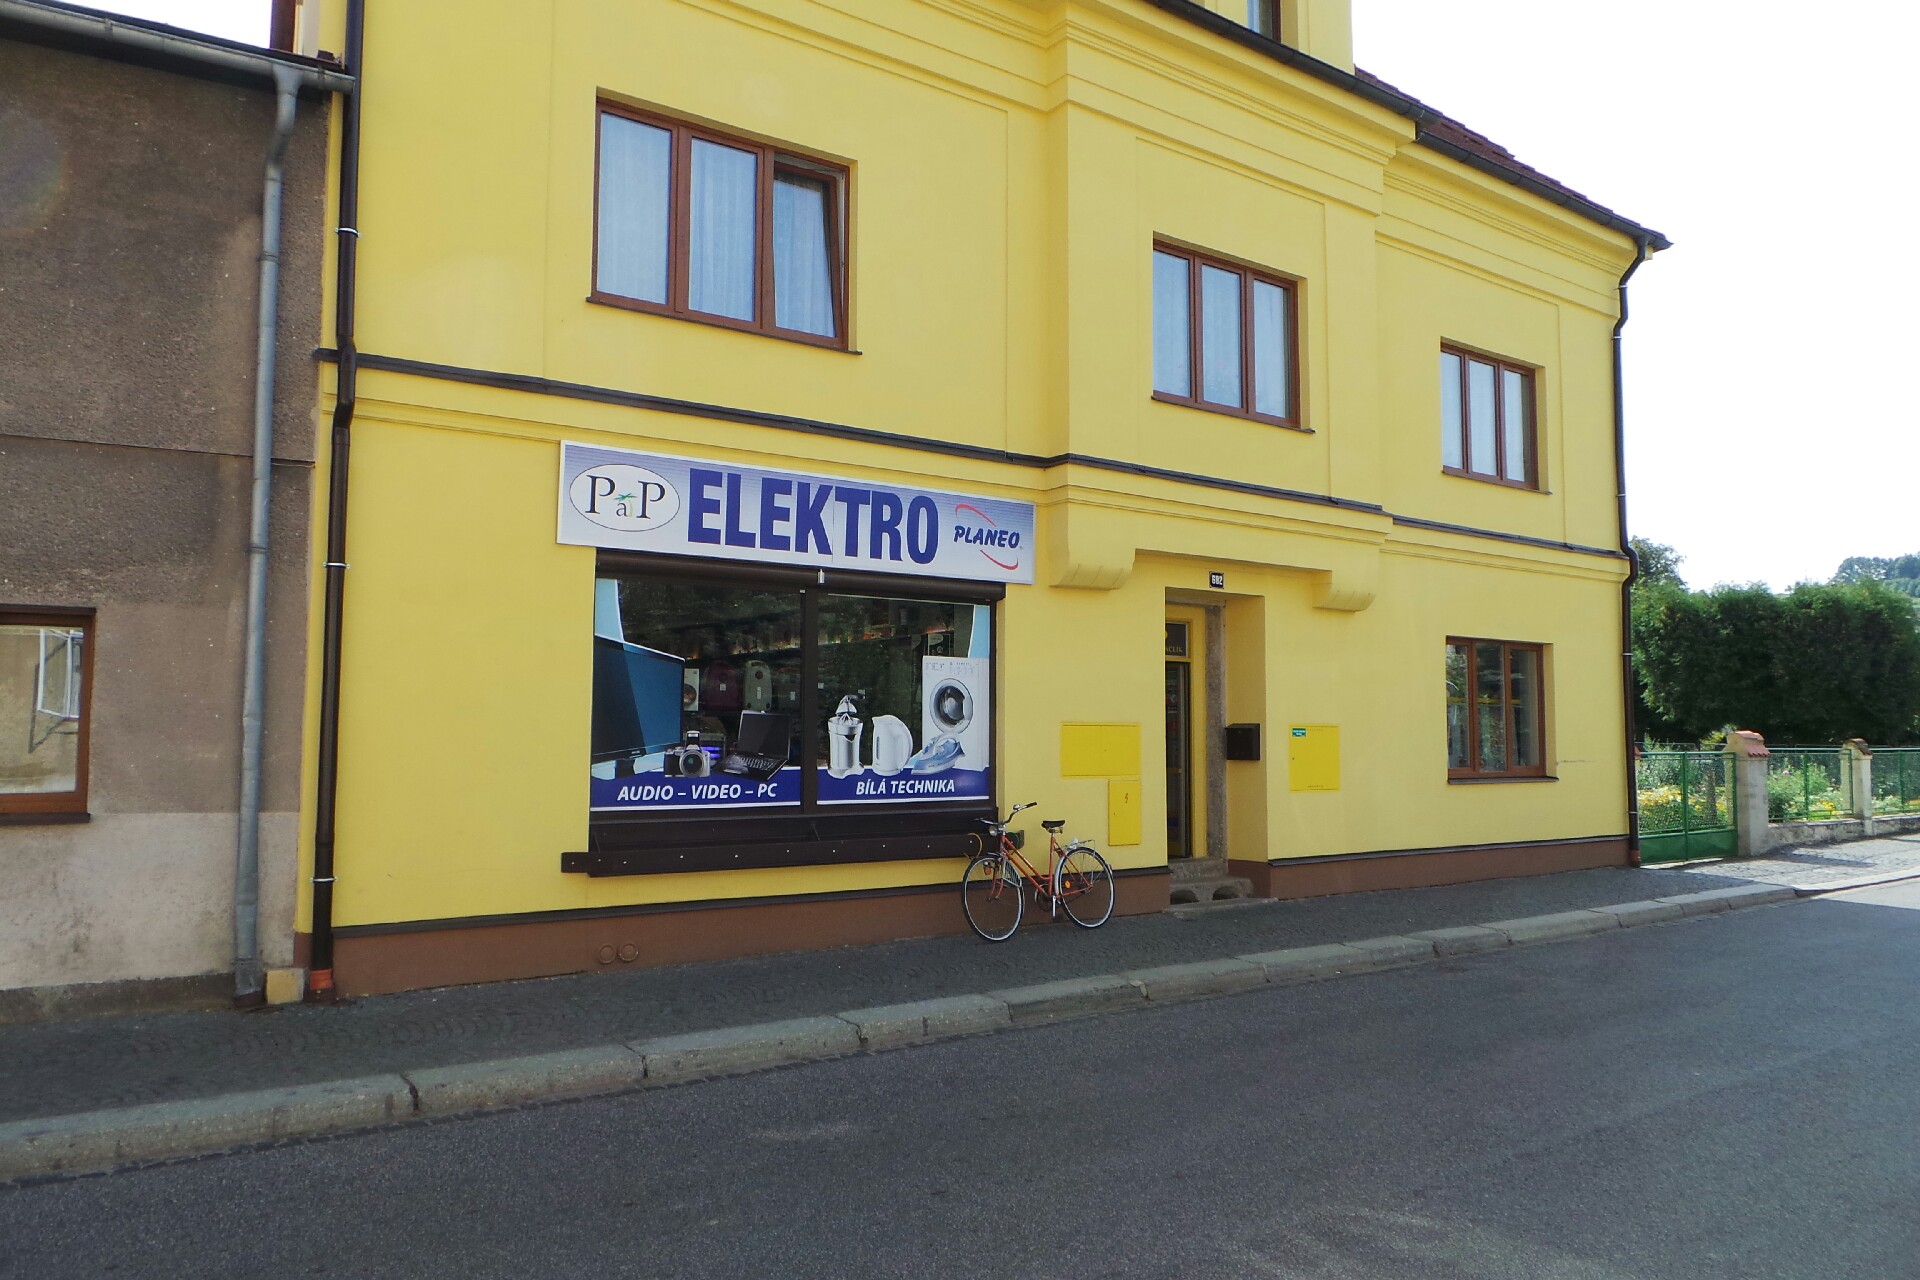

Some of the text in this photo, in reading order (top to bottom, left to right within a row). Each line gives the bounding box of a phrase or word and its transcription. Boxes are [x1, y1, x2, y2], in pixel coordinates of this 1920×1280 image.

[688, 468, 939, 565] ELEKTRO
[953, 525, 1020, 549] PLANEO
[617, 785, 674, 801] AUDIO
[691, 784, 741, 799] VIDEO
[757, 783, 778, 798] PC
[856, 779, 955, 795] BÍLÁ TECHNIKA
